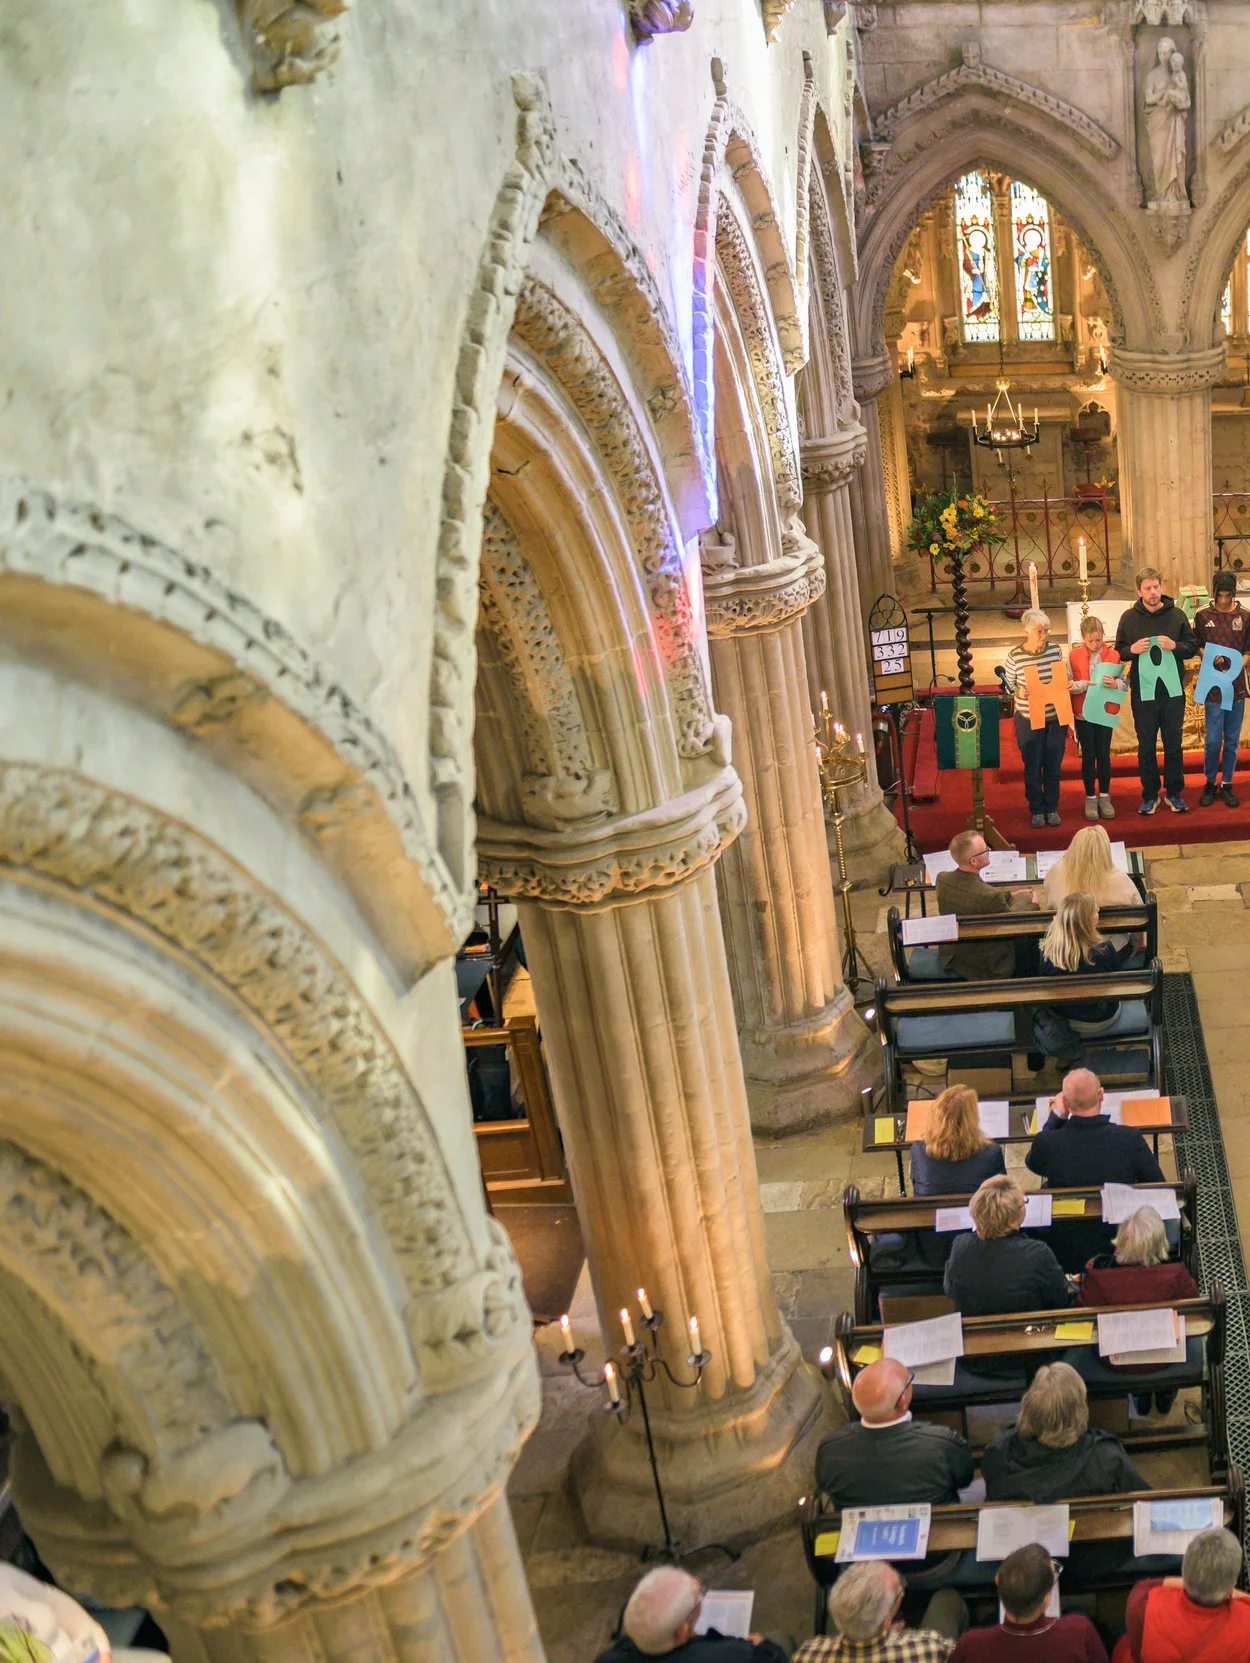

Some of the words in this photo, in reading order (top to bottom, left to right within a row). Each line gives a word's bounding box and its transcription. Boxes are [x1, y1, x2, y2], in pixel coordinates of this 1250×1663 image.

[873, 629, 905, 643] 719
[877, 643, 905, 658] 332
[884, 660, 902, 673] 25
